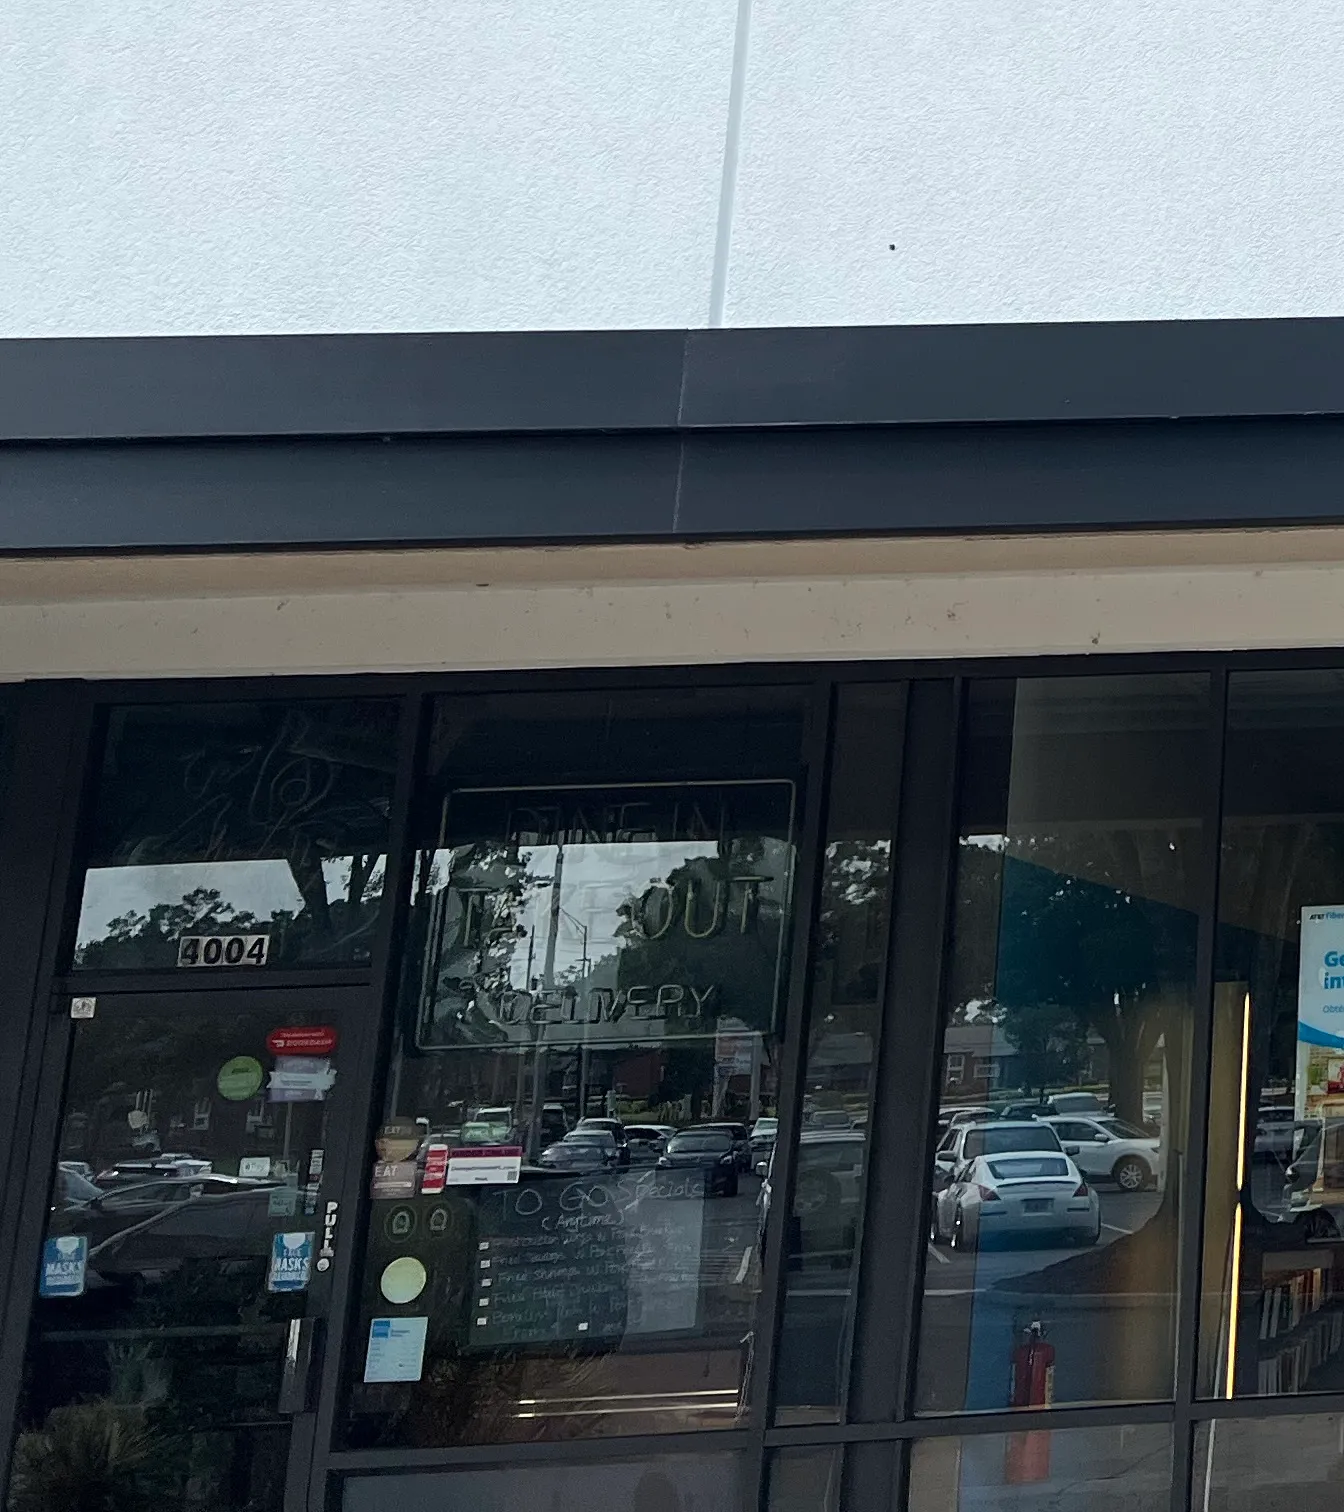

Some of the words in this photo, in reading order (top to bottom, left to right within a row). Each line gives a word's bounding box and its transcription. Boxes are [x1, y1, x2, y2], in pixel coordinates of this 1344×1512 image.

[629, 875, 774, 941] OUT
[180, 937, 266, 965] 4004
[492, 1188, 543, 1220] TO
[559, 1181, 609, 1211] GO
[322, 1201, 339, 1257] PULL
